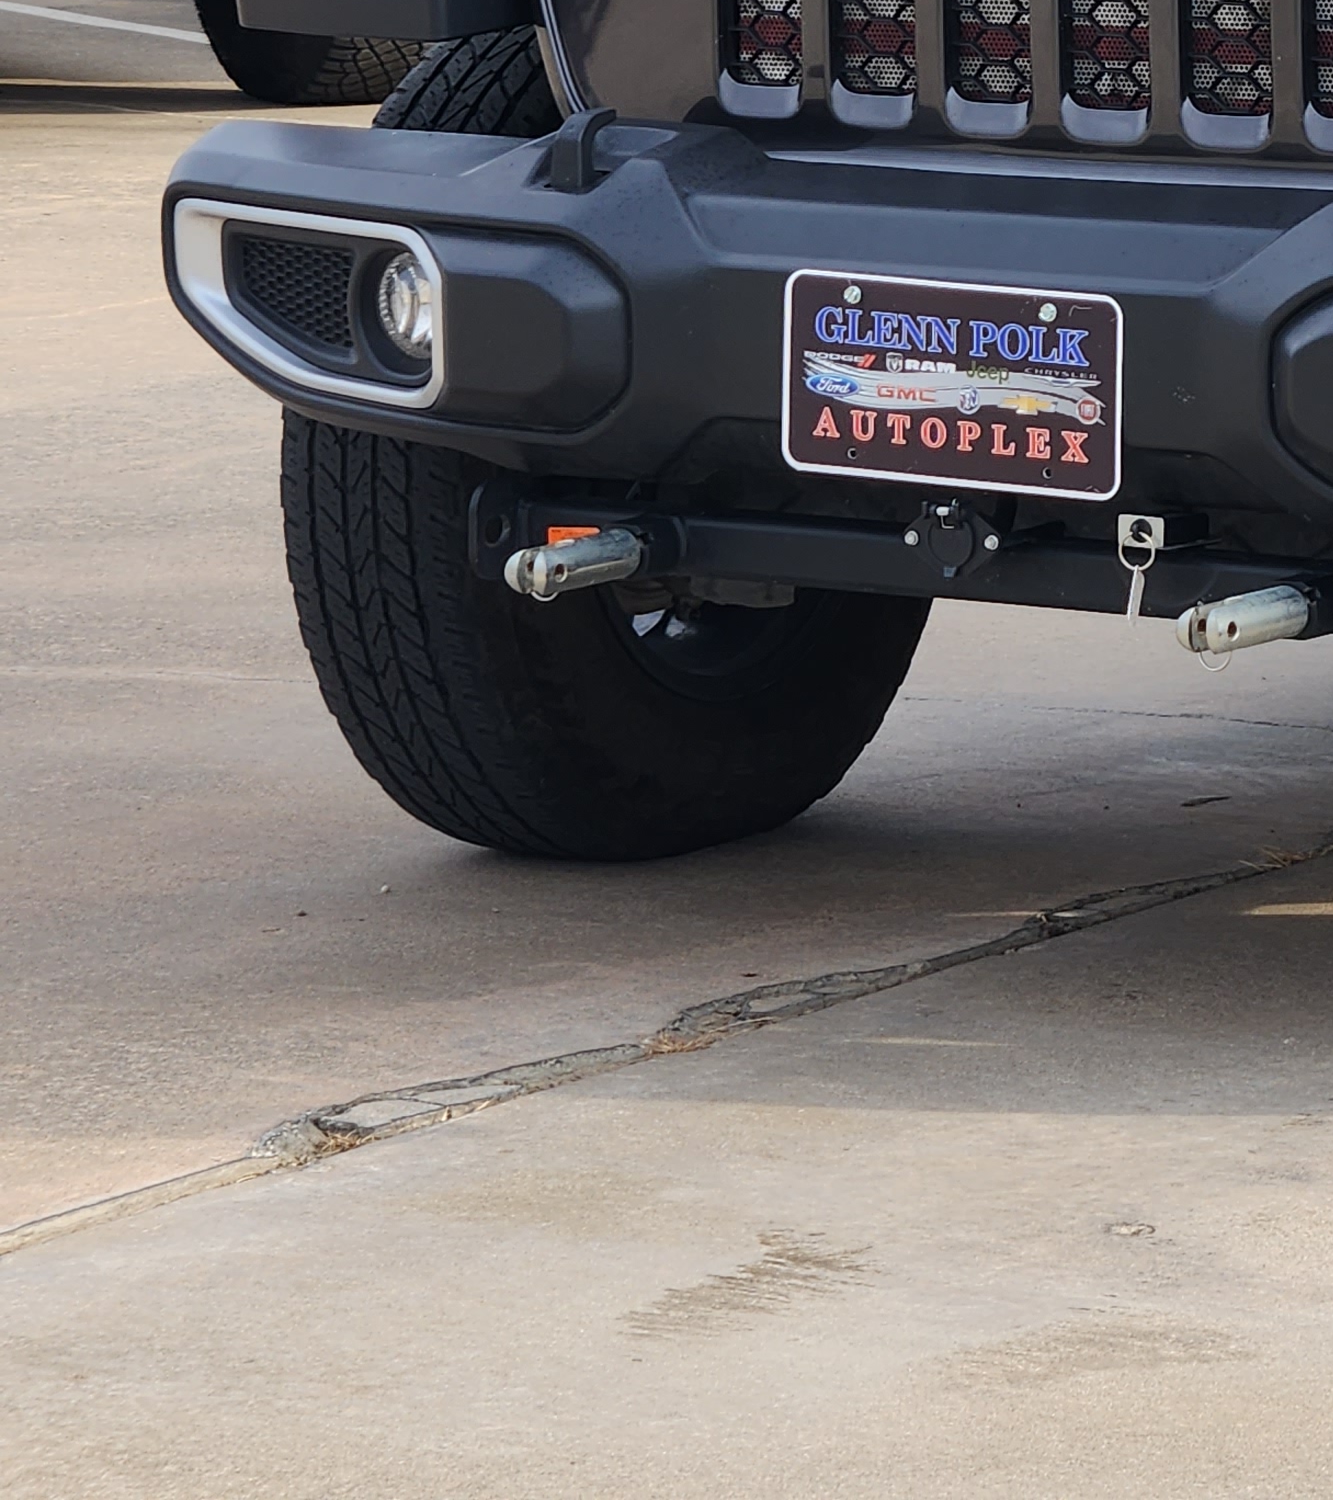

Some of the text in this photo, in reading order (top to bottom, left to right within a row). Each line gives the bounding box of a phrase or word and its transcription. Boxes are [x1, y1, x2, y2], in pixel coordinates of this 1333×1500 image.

[815, 305, 1091, 367] GLENN POLK
[804, 350, 1099, 384] DODGE RAM Jeep CHRYSLER
[815, 375, 938, 403] Ford GMC
[812, 406, 1091, 464] AUTOPLEX
